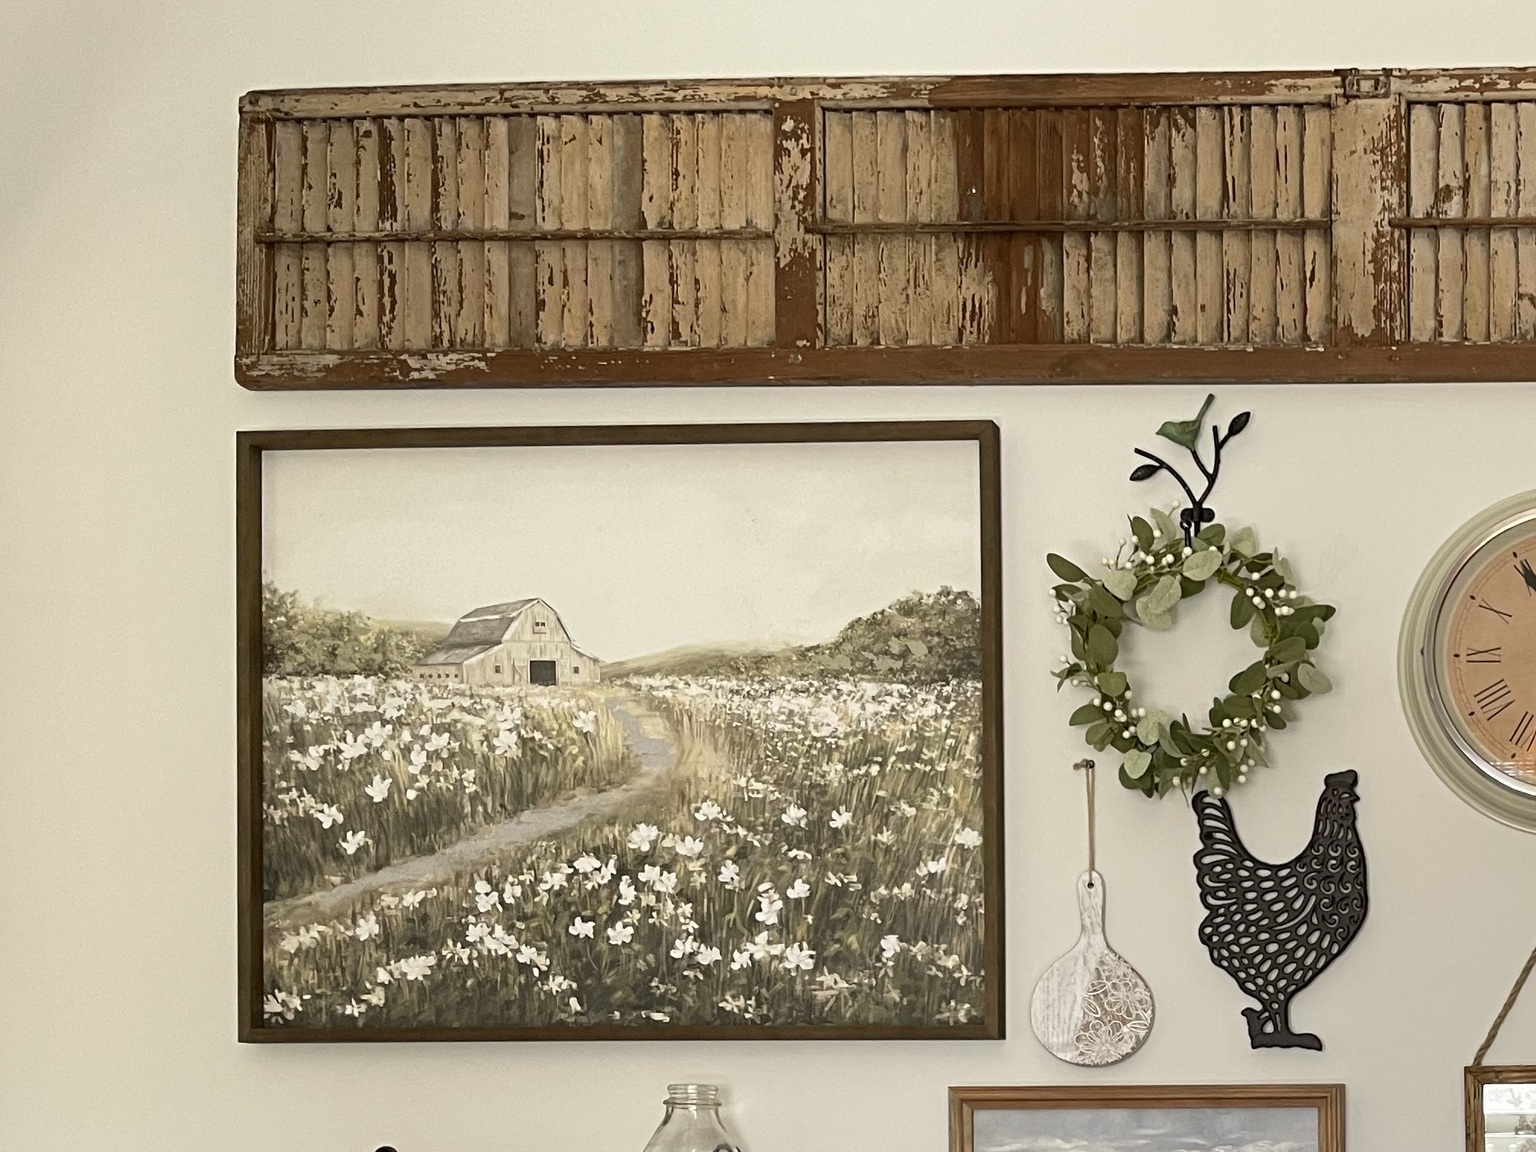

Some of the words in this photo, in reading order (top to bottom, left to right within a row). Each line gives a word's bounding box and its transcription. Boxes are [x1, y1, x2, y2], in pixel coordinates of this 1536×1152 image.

[1478, 598, 1513, 624] X
[1466, 646, 1501, 664] IX
[1473, 678, 1516, 721] VIII
